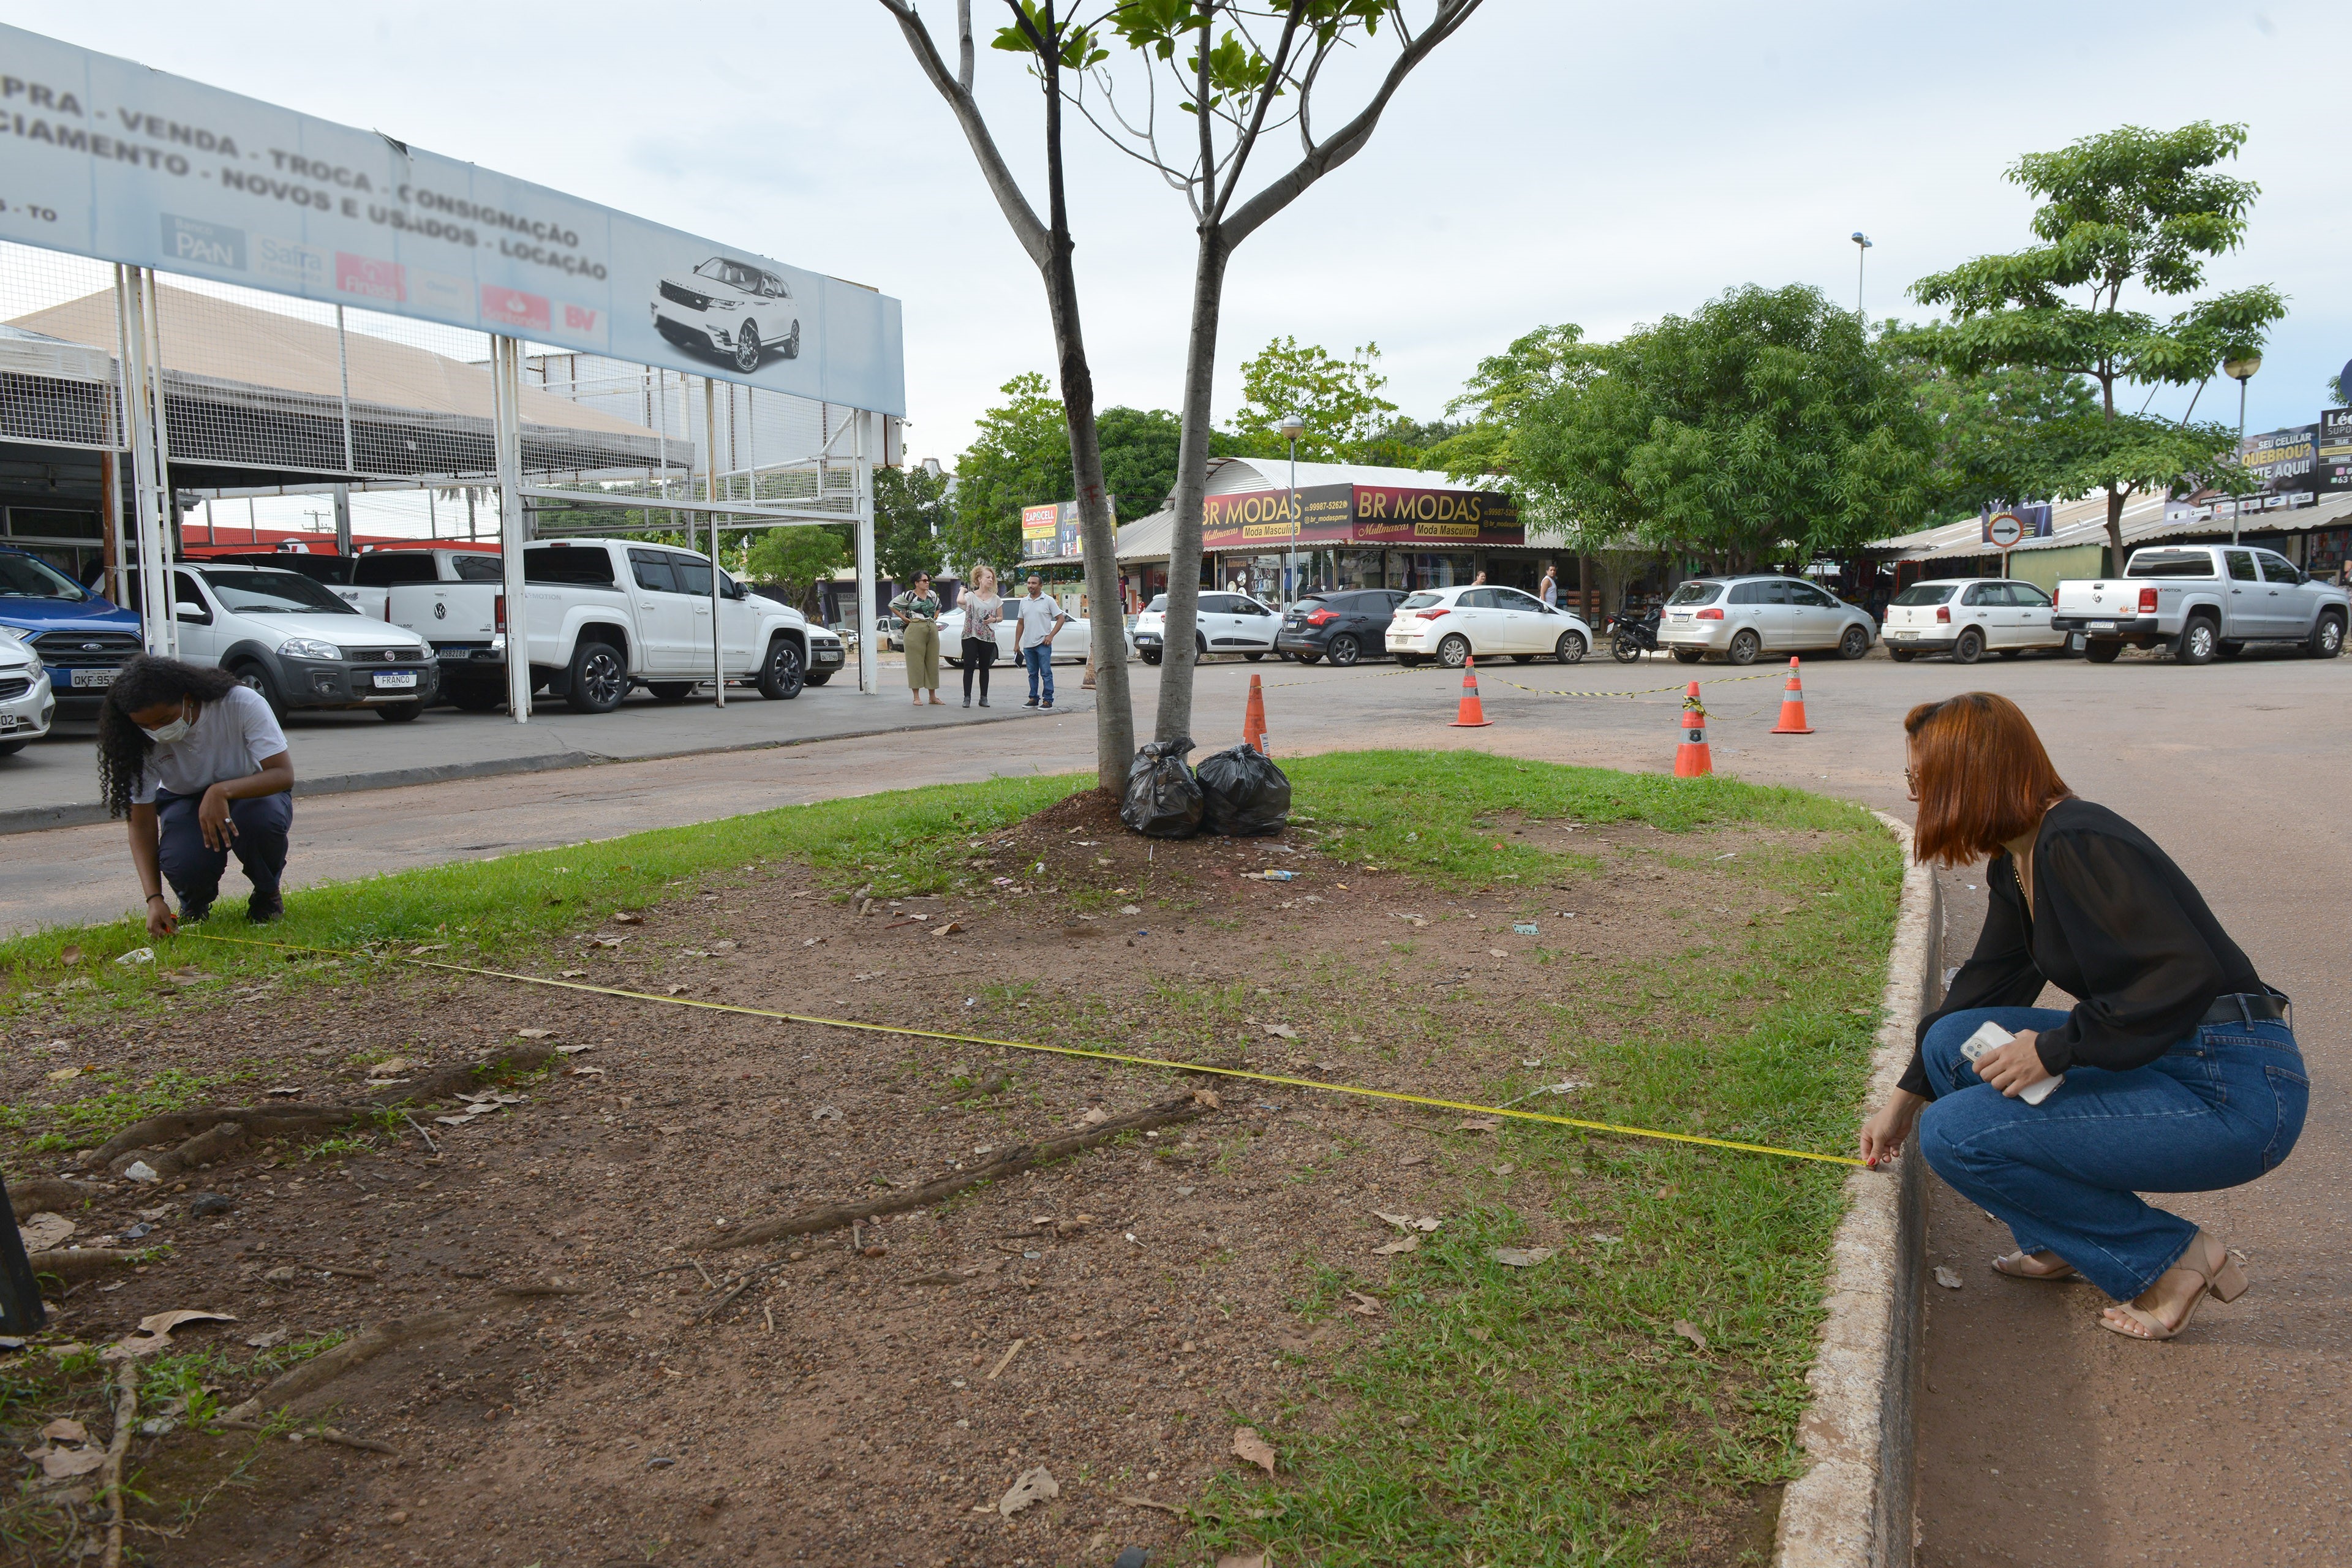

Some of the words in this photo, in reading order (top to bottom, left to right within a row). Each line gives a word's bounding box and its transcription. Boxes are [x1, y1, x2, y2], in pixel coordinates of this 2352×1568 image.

[118, 106, 240, 159] VENDA
[268, 148, 374, 193] TROCA
[397, 183, 579, 247] CONSIGNAÇÃO
[28, 203, 58, 222] TO
[221, 166, 331, 212] NOVOS
[340, 194, 360, 219] E
[369, 203, 477, 247] USADOS
[499, 238, 607, 281] LOCAÇÃO
[176, 232, 233, 266] PAN
[260, 238, 323, 271] Safra
[483, 306, 550, 331] Santander
[565, 304, 597, 331] BV
[2258, 439, 2274, 450] SEU
[2275, 432, 2312, 447] CELULAR
[2242, 443, 2312, 467] QUEBROU?
[2275, 460, 2310, 478] AQUI!
[1202, 502, 1219, 526] BR
[1226, 494, 1302, 524] MODAS
[1358, 492, 1387, 518] BR
[1393, 493, 1482, 522] MODAS
[1245, 527, 1262, 537] Moda
[1417, 525, 1438, 535] Moda
[1439, 526, 1477, 536] Masculina
[382, 676, 410, 684] FRANCO
